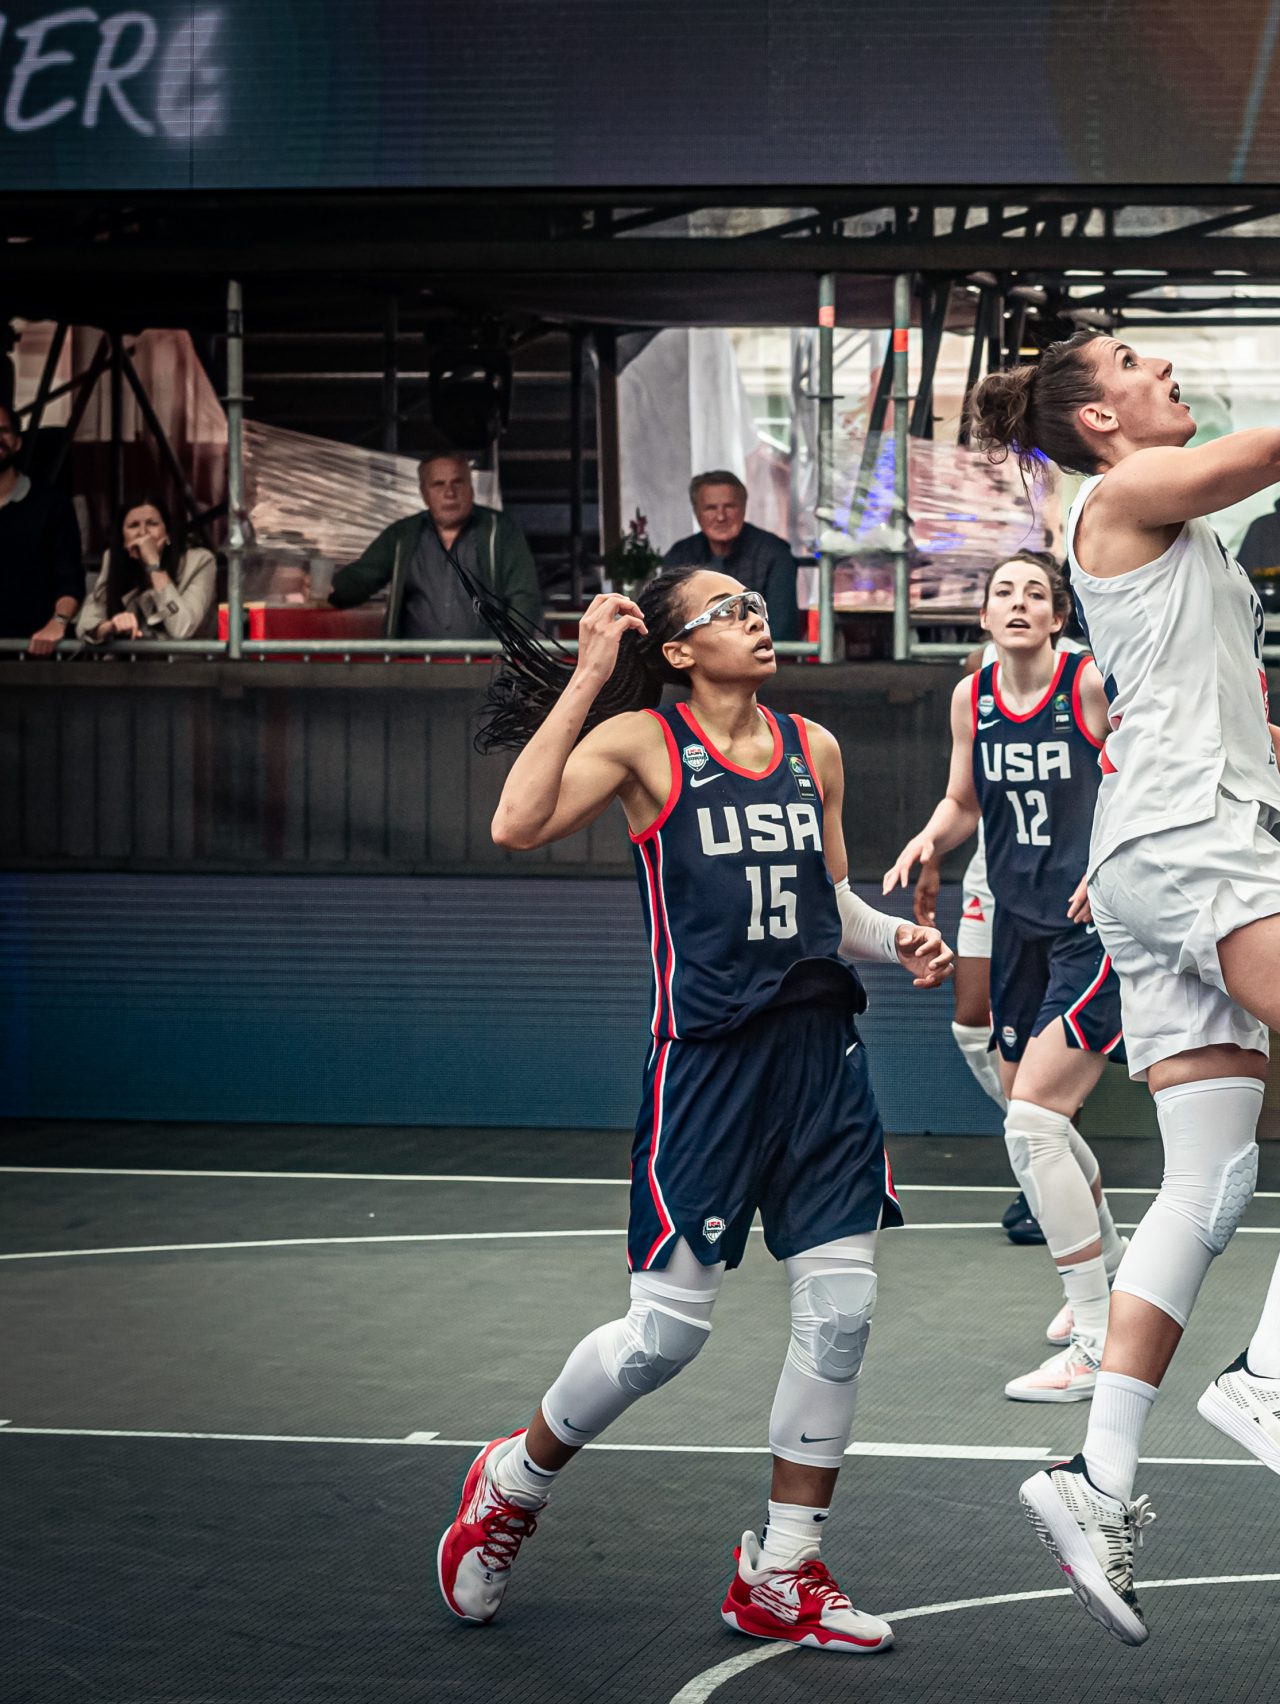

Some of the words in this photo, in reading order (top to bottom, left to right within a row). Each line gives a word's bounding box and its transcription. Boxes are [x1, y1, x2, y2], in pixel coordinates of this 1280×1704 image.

[0, 7, 222, 138] ERG
[981, 741, 1071, 782] USA
[697, 803, 822, 856] USA
[1006, 790, 1051, 847] 12
[745, 864, 799, 941] 15
